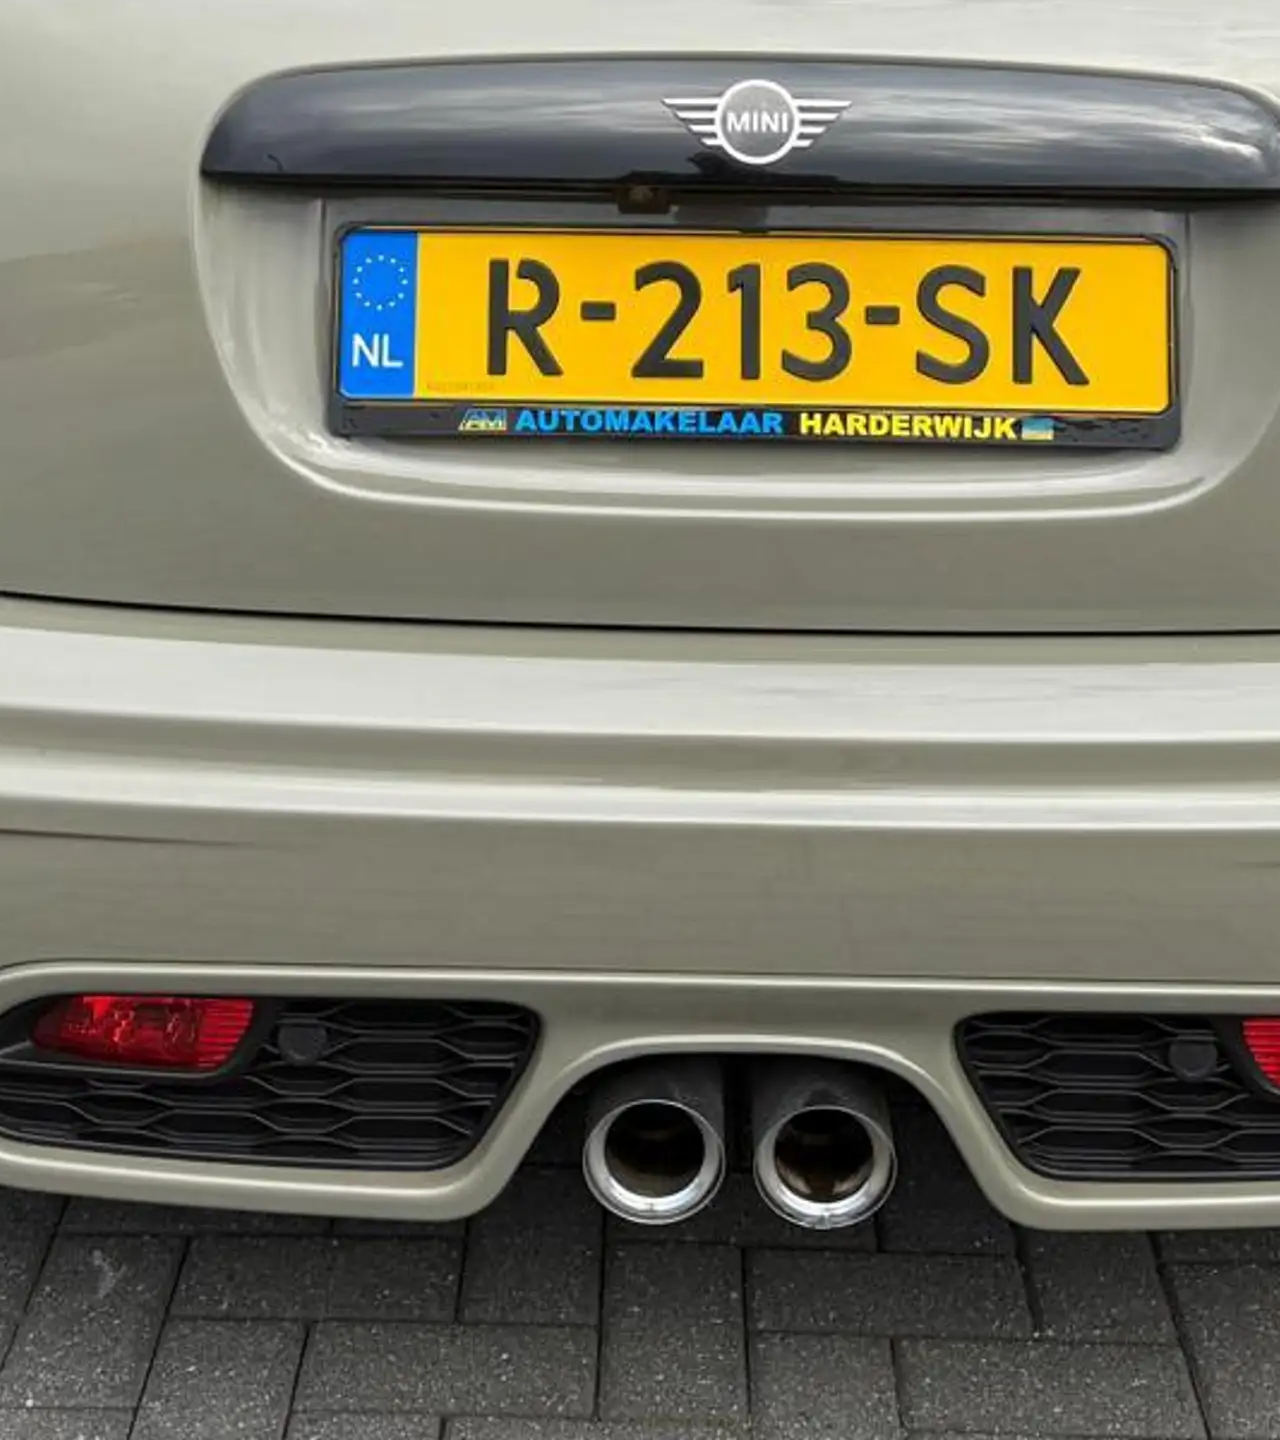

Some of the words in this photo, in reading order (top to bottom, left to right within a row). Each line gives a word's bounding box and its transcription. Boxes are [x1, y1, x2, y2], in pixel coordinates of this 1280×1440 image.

[726, 109, 789, 134] MINI
[488, 256, 1090, 386] R-213-SK
[352, 333, 403, 368] NL
[515, 409, 784, 437] AUTOMAKELAAR
[798, 412, 1017, 441] HARDERWIJK
